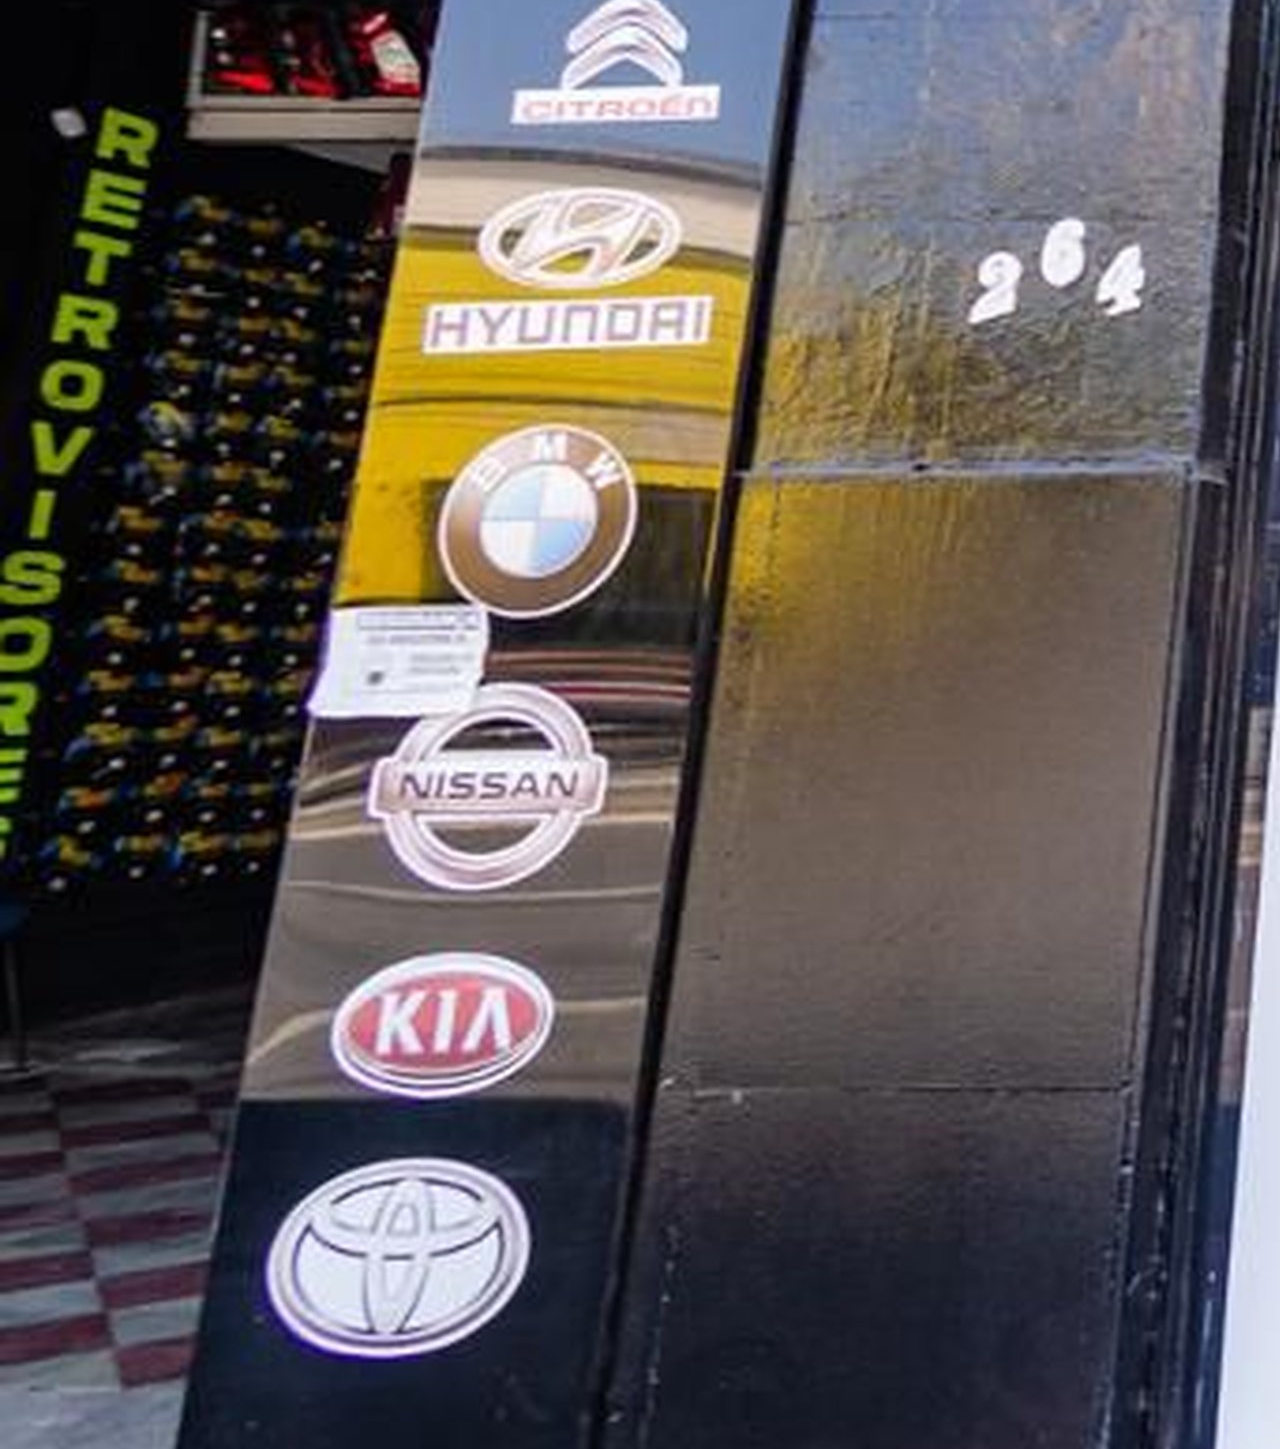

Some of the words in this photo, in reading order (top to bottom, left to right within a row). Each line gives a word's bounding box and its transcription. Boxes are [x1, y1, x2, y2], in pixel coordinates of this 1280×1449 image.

[967, 217, 1146, 325] 264
[430, 300, 707, 348] HYUNDAI
[0, 105, 162, 859] RETROVISOR
[471, 434, 624, 492] BMW
[400, 770, 579, 802] NISSAN
[374, 987, 514, 1056] KIA
